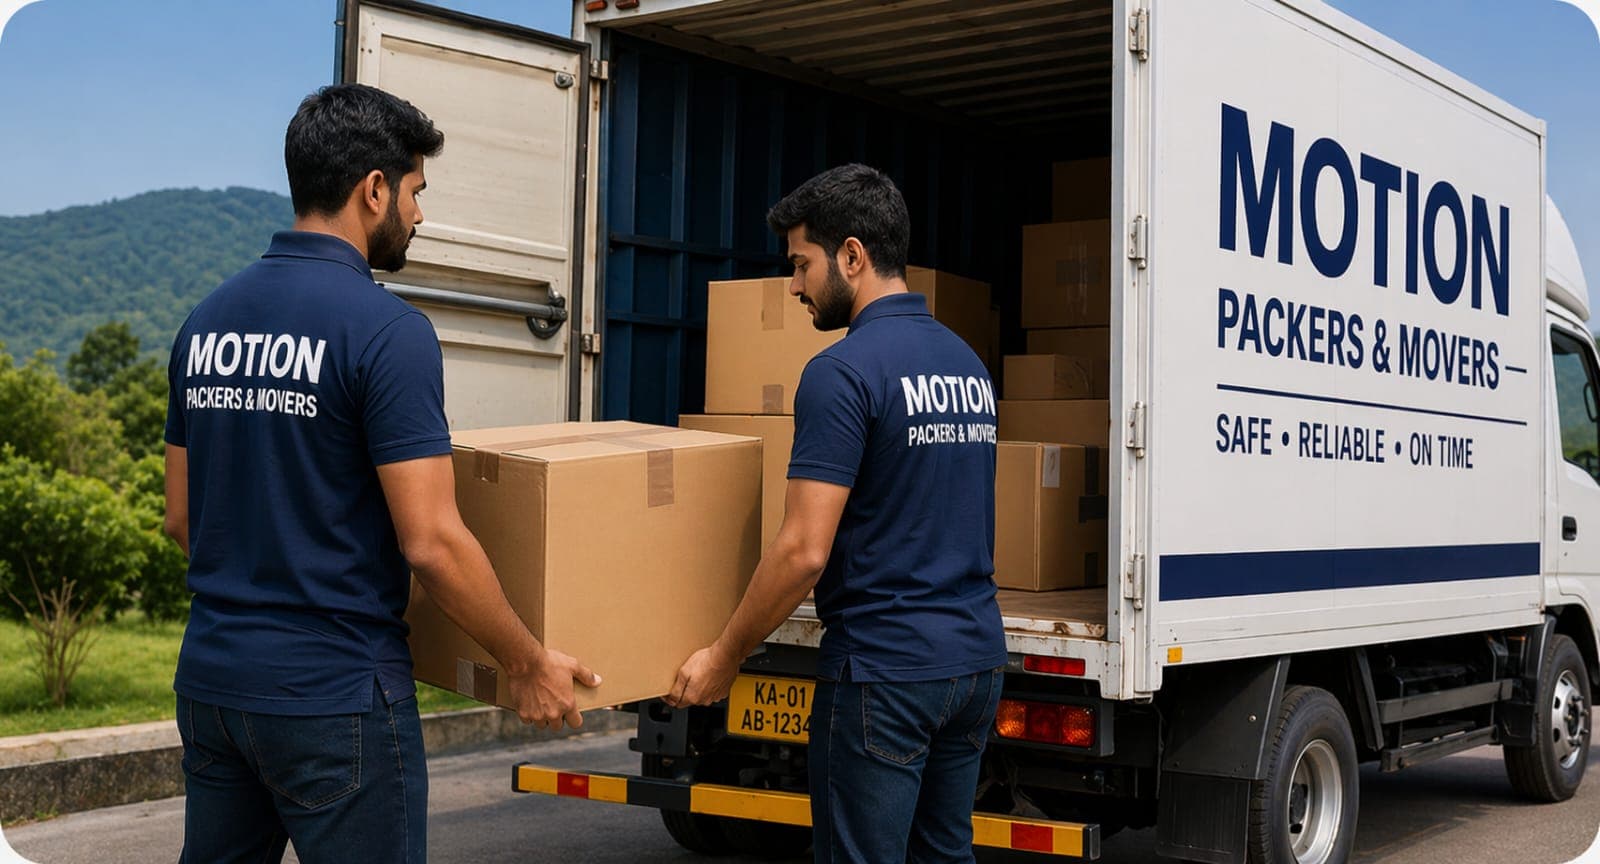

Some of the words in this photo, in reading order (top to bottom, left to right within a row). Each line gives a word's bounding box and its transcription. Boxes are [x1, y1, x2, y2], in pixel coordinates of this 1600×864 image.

[1219, 102, 1510, 317] MOTION
[186, 332, 327, 385] MOTION
[1217, 287, 1364, 370] PACKERS
[1372, 318, 1391, 374] &
[1399, 323, 1500, 391] MOVERS
[186, 386, 243, 411] PACKERS
[245, 387, 255, 411] &
[256, 388, 318, 419] MOVERS
[900, 374, 996, 417] MOTION
[908, 423, 956, 447] PACKERS
[958, 423, 966, 443] &
[1216, 413, 1272, 456] SAFE
[1298, 421, 1386, 464] RELIABLE
[1409, 431, 1433, 467] ON
[1438, 435, 1474, 470] TIME
[754, 681, 806, 709] KA-01
[741, 708, 811, 736] AB-1234
